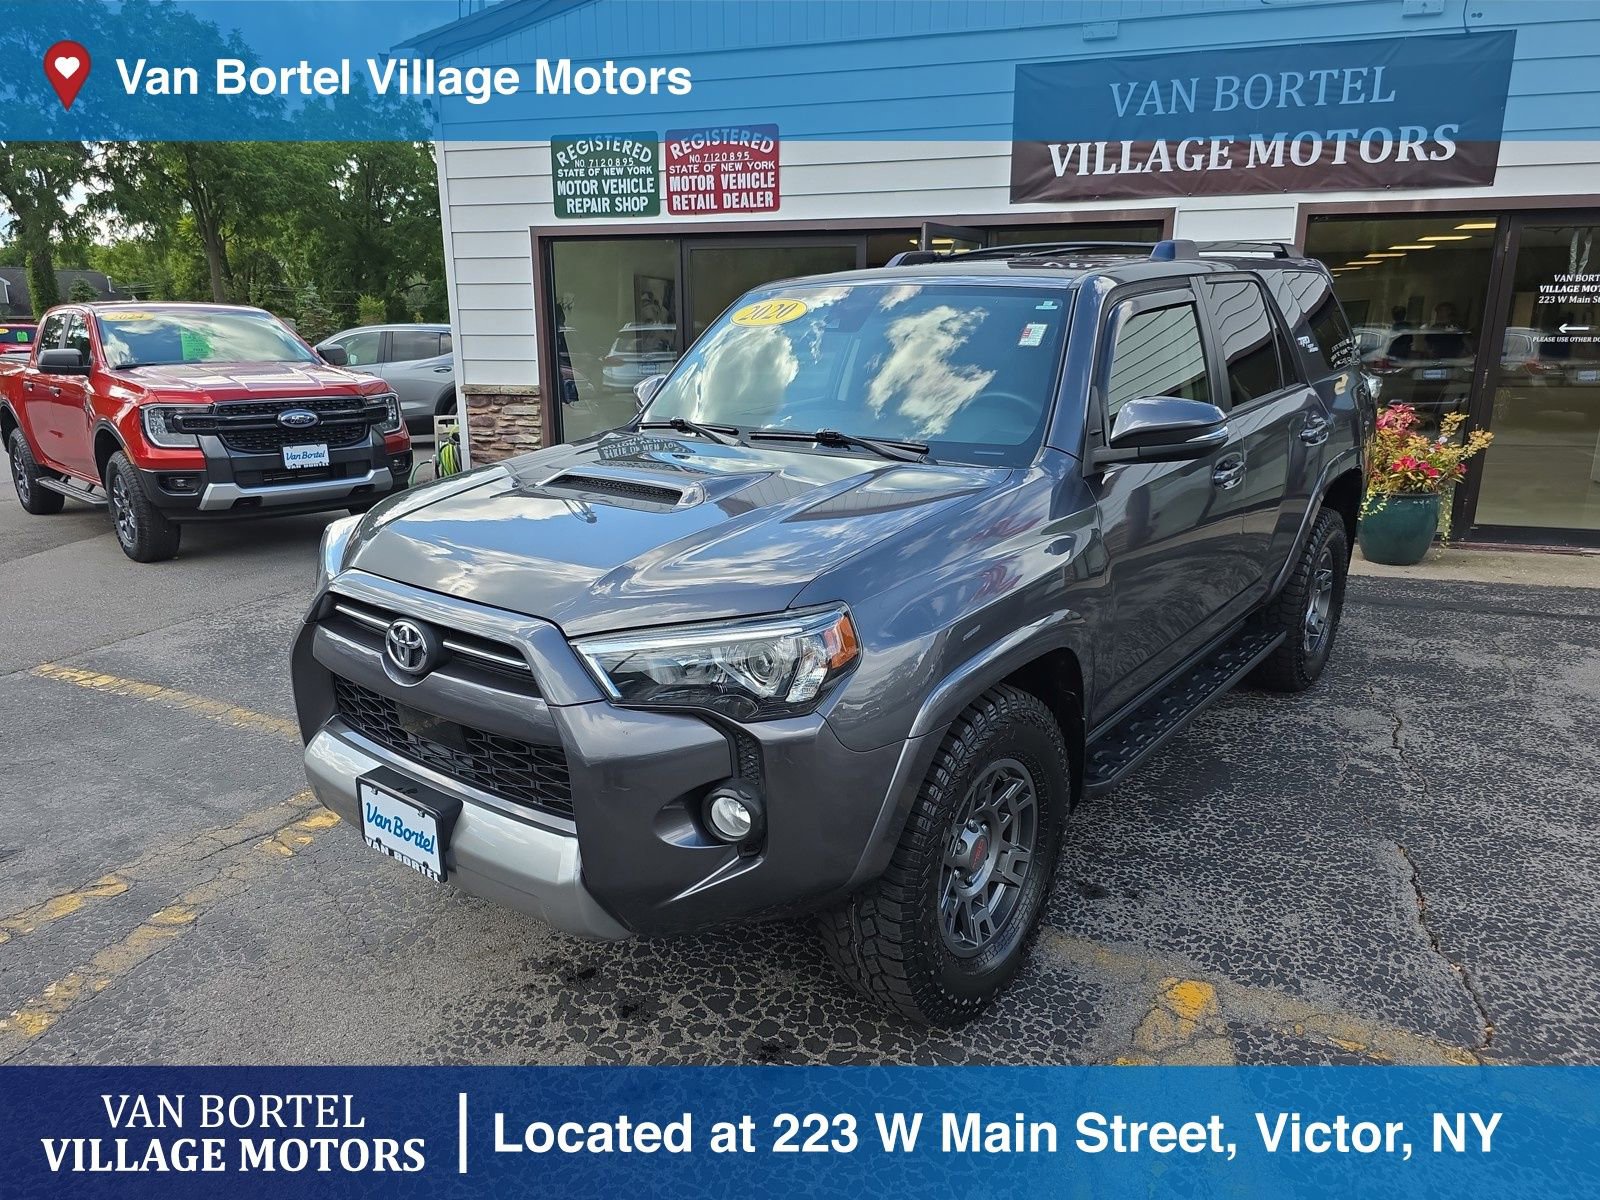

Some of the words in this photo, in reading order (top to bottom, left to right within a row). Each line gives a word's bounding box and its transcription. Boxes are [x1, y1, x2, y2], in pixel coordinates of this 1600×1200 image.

[1110, 77, 1199, 117] VAN
[1212, 66, 1395, 112] BORTEL
[556, 135, 652, 167] REGISTERED
[669, 128, 774, 160] REGISTERED
[1048, 136, 1235, 177] VILLAGE
[1246, 124, 1459, 168] MOTORS
[557, 168, 585, 177] STATE
[588, 168, 600, 176] OF
[603, 167, 624, 176] NEW
[627, 166, 653, 175] YORK
[669, 164, 700, 174] STATE
[703, 163, 717, 172] OF
[721, 162, 743, 172] NEW
[747, 160, 775, 170] YORK
[557, 179, 599, 196] MOTOR
[601, 177, 655, 194] VEHICLE
[669, 174, 715, 192] MOTOR
[720, 171, 775, 190] VEHICLE
[566, 197, 610, 213] REPAIR
[615, 196, 648, 213] SHOP
[672, 193, 718, 211] RETAIL
[723, 191, 774, 209] DEALER
[1554, 274, 1574, 282] VAN
[1540, 285, 1580, 293] VILLAGE
[1538, 295, 1555, 304] 223
[1557, 295, 1567, 304] W
[1569, 295, 1591, 304] Main
[737, 302, 799, 321] 2020
